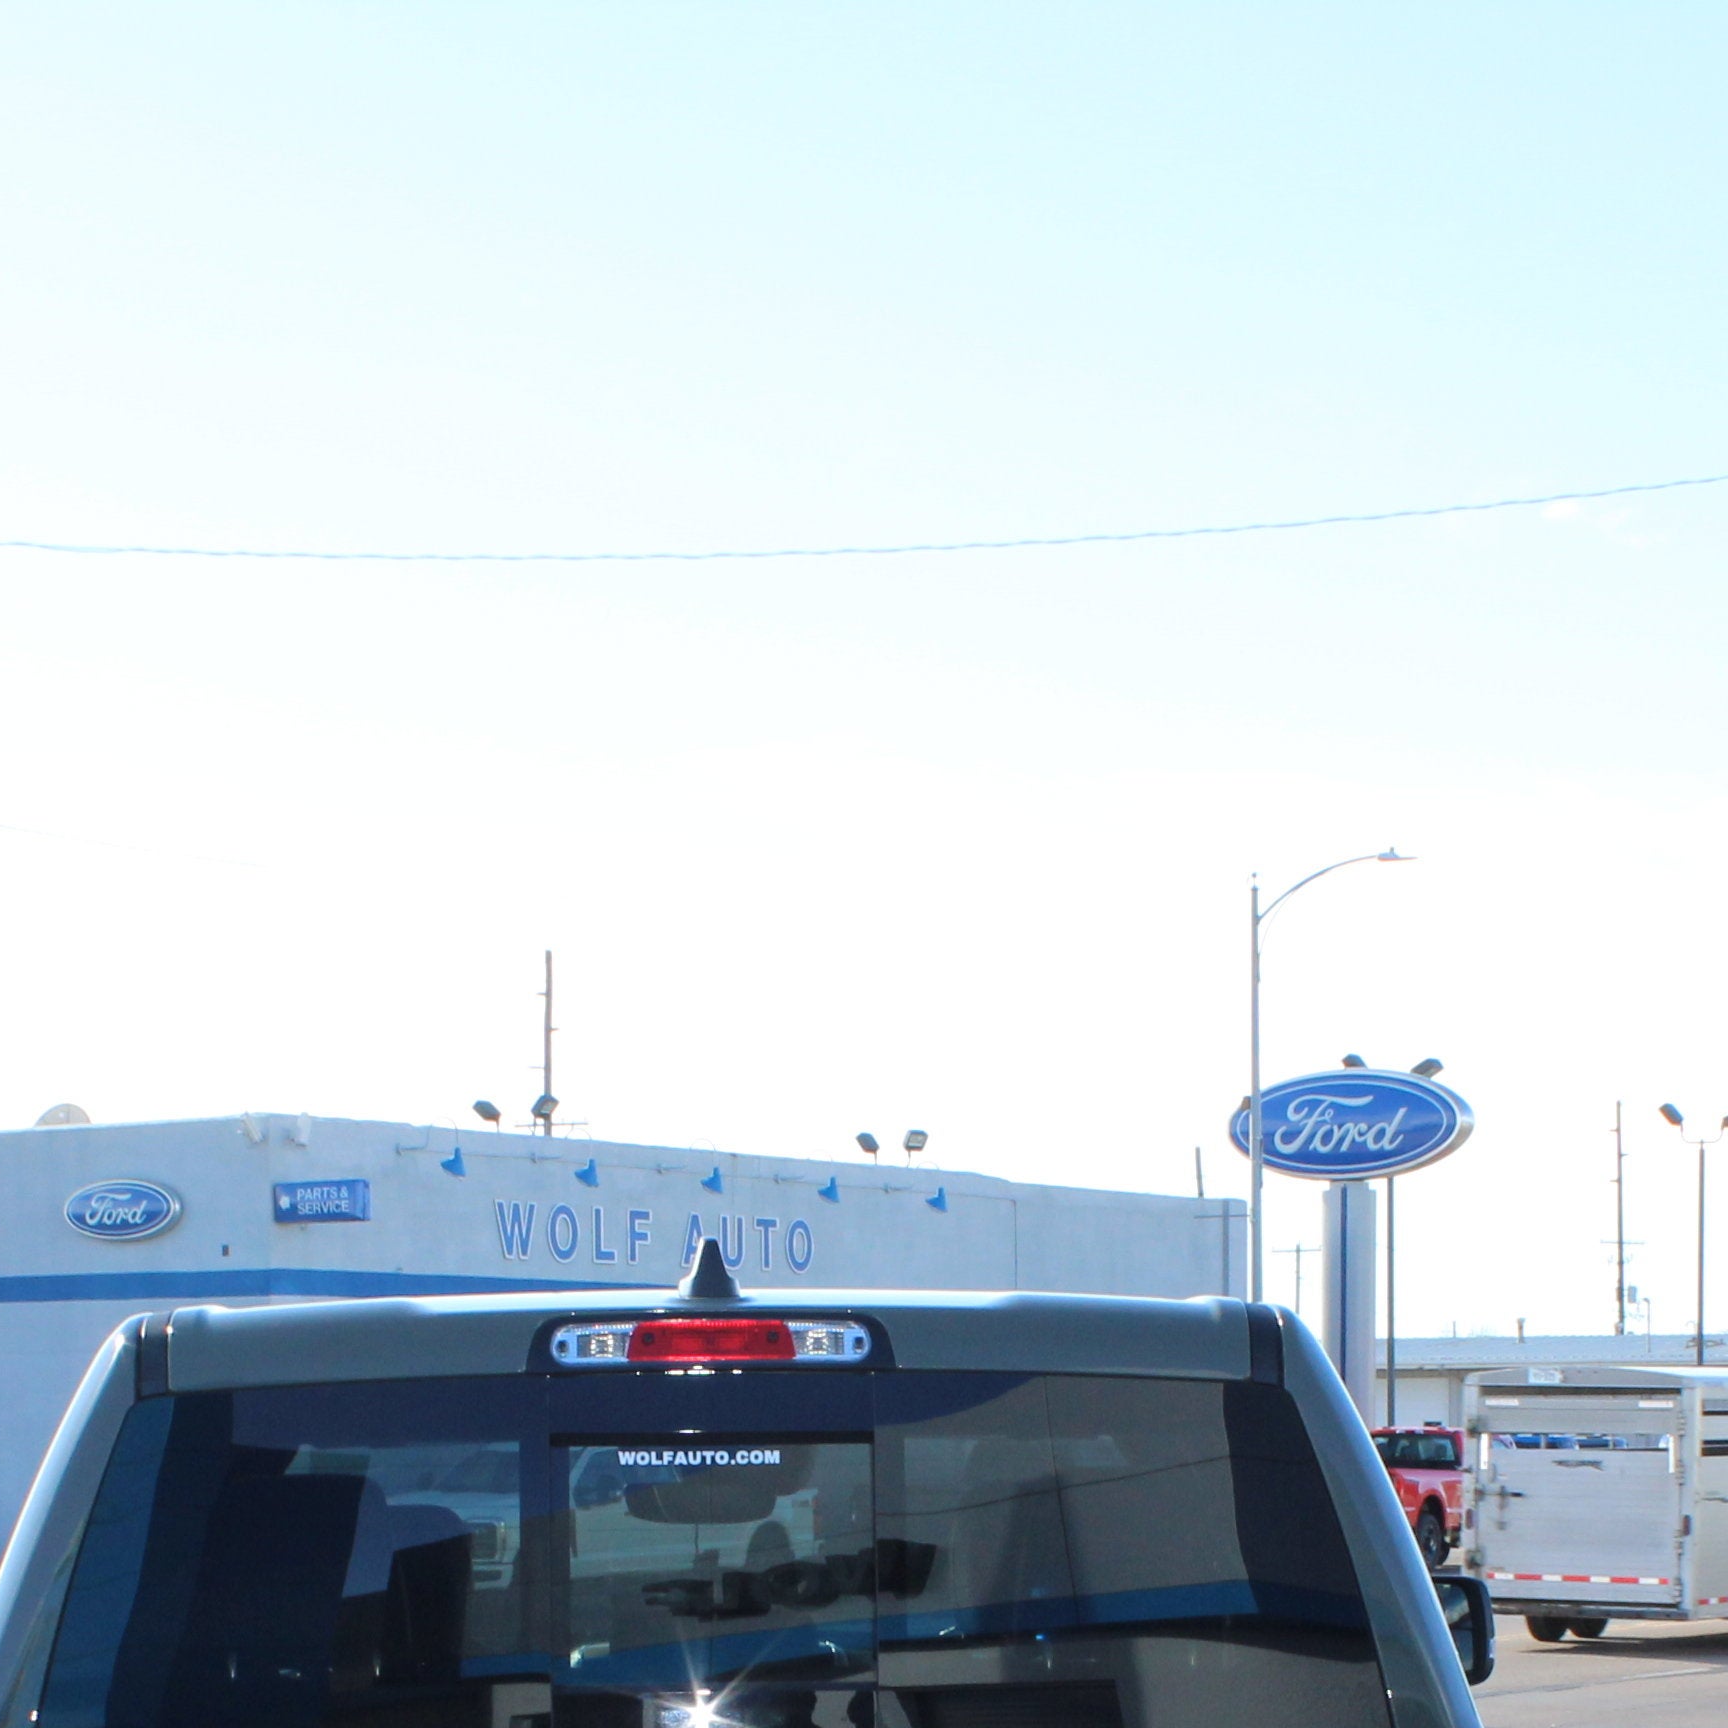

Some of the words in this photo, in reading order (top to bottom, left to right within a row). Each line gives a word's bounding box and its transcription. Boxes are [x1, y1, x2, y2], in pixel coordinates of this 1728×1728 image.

[1273, 1093, 1408, 1155] Ford
[296, 1187, 338, 1201] PARTS
[339, 1187, 349, 1199] &
[84, 1191, 148, 1226] Ford
[296, 1200, 350, 1215] SERVICE
[495, 1199, 653, 1265] WOLF
[681, 1211, 815, 1274] AUTO
[618, 1449, 781, 1466] WOLFAUTO.COM
